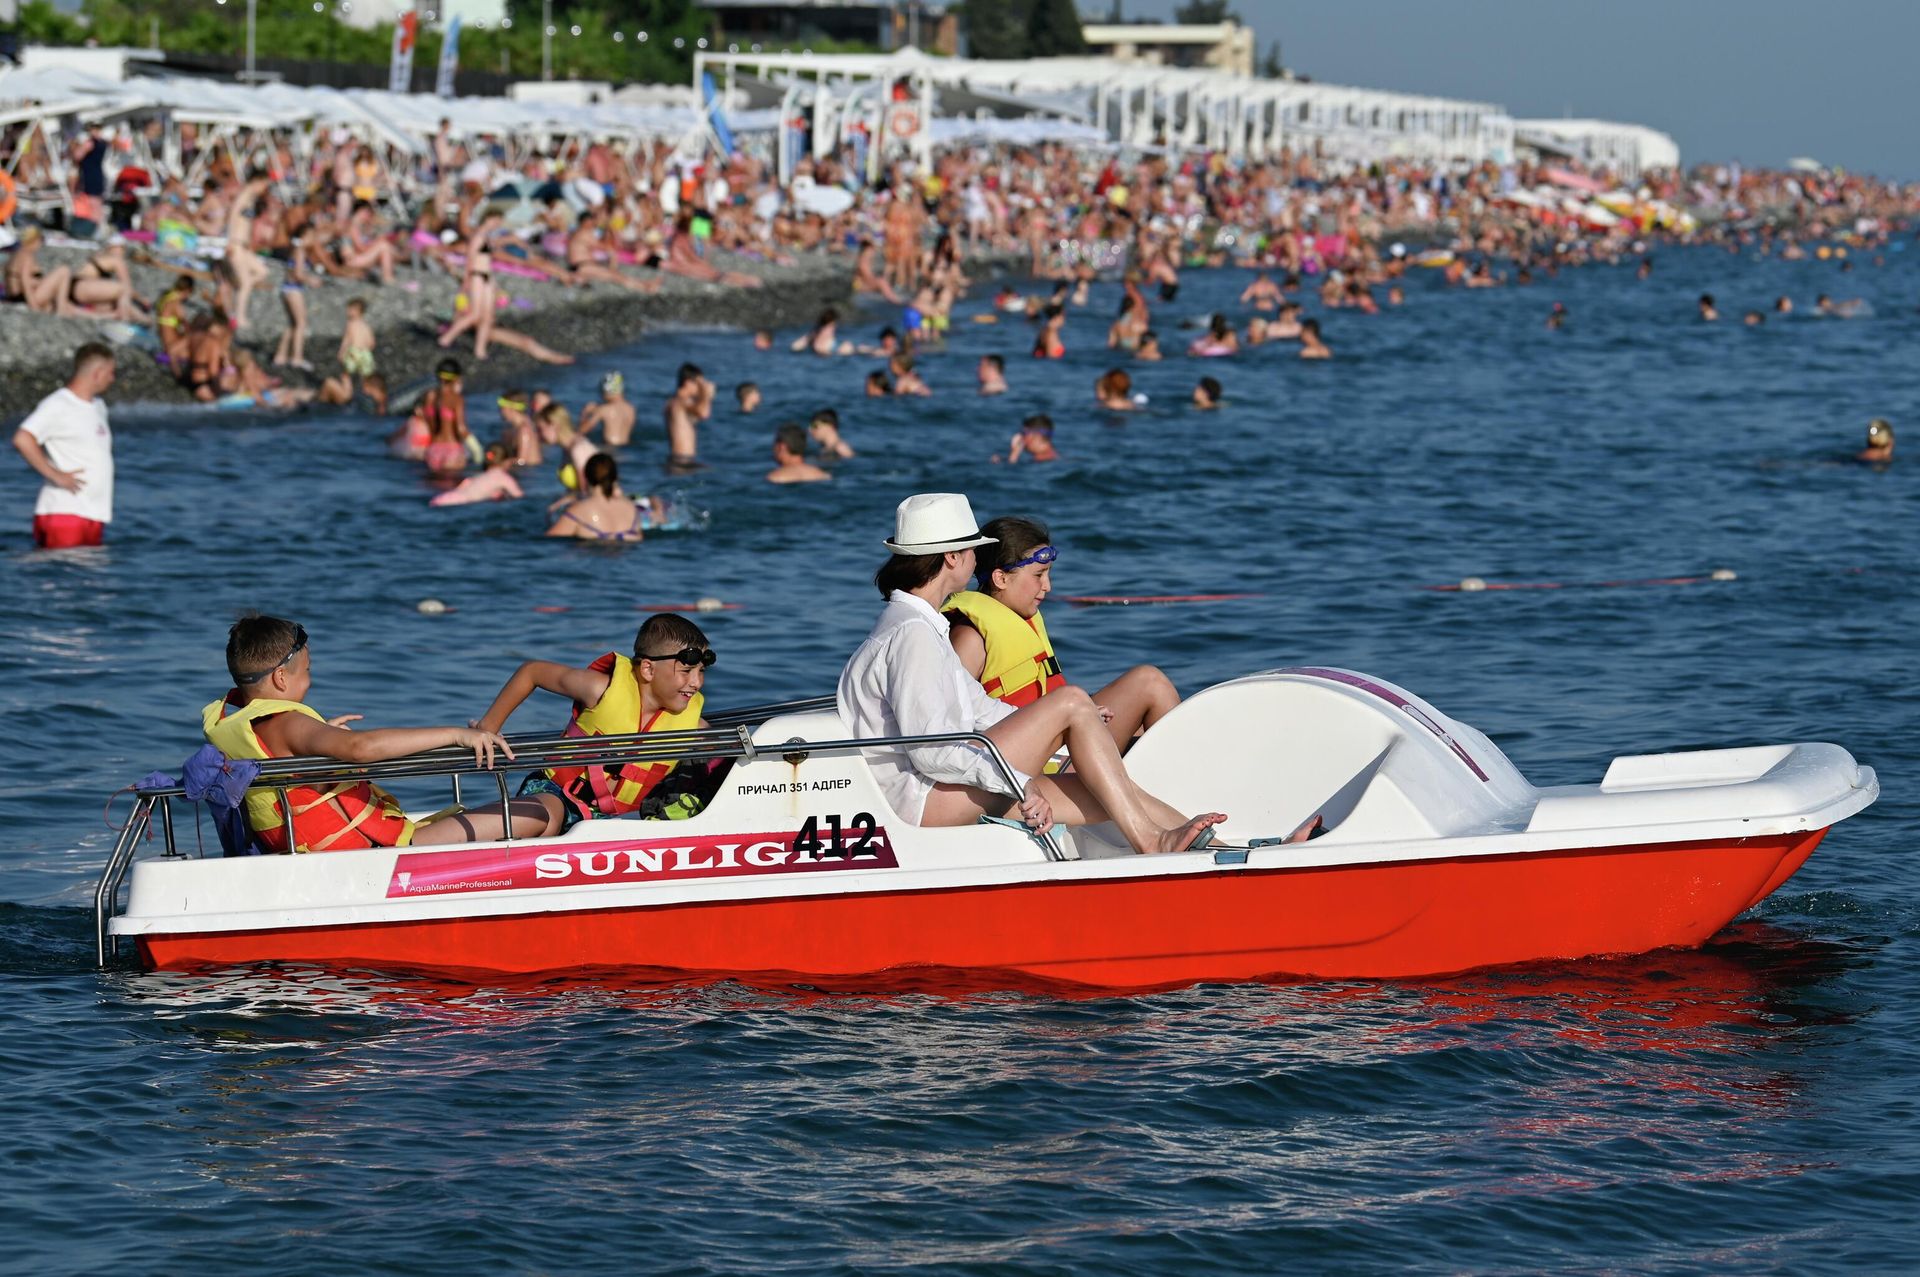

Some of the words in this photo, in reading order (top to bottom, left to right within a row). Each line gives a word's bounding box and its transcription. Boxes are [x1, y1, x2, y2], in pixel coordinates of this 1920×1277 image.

[738, 785, 786, 795] ПРИЧАЛ
[790, 782, 808, 792] 351
[812, 779, 852, 791] АДЛЕР
[793, 812, 876, 858] 412
[410, 879, 512, 893] AquaMarineProfessional
